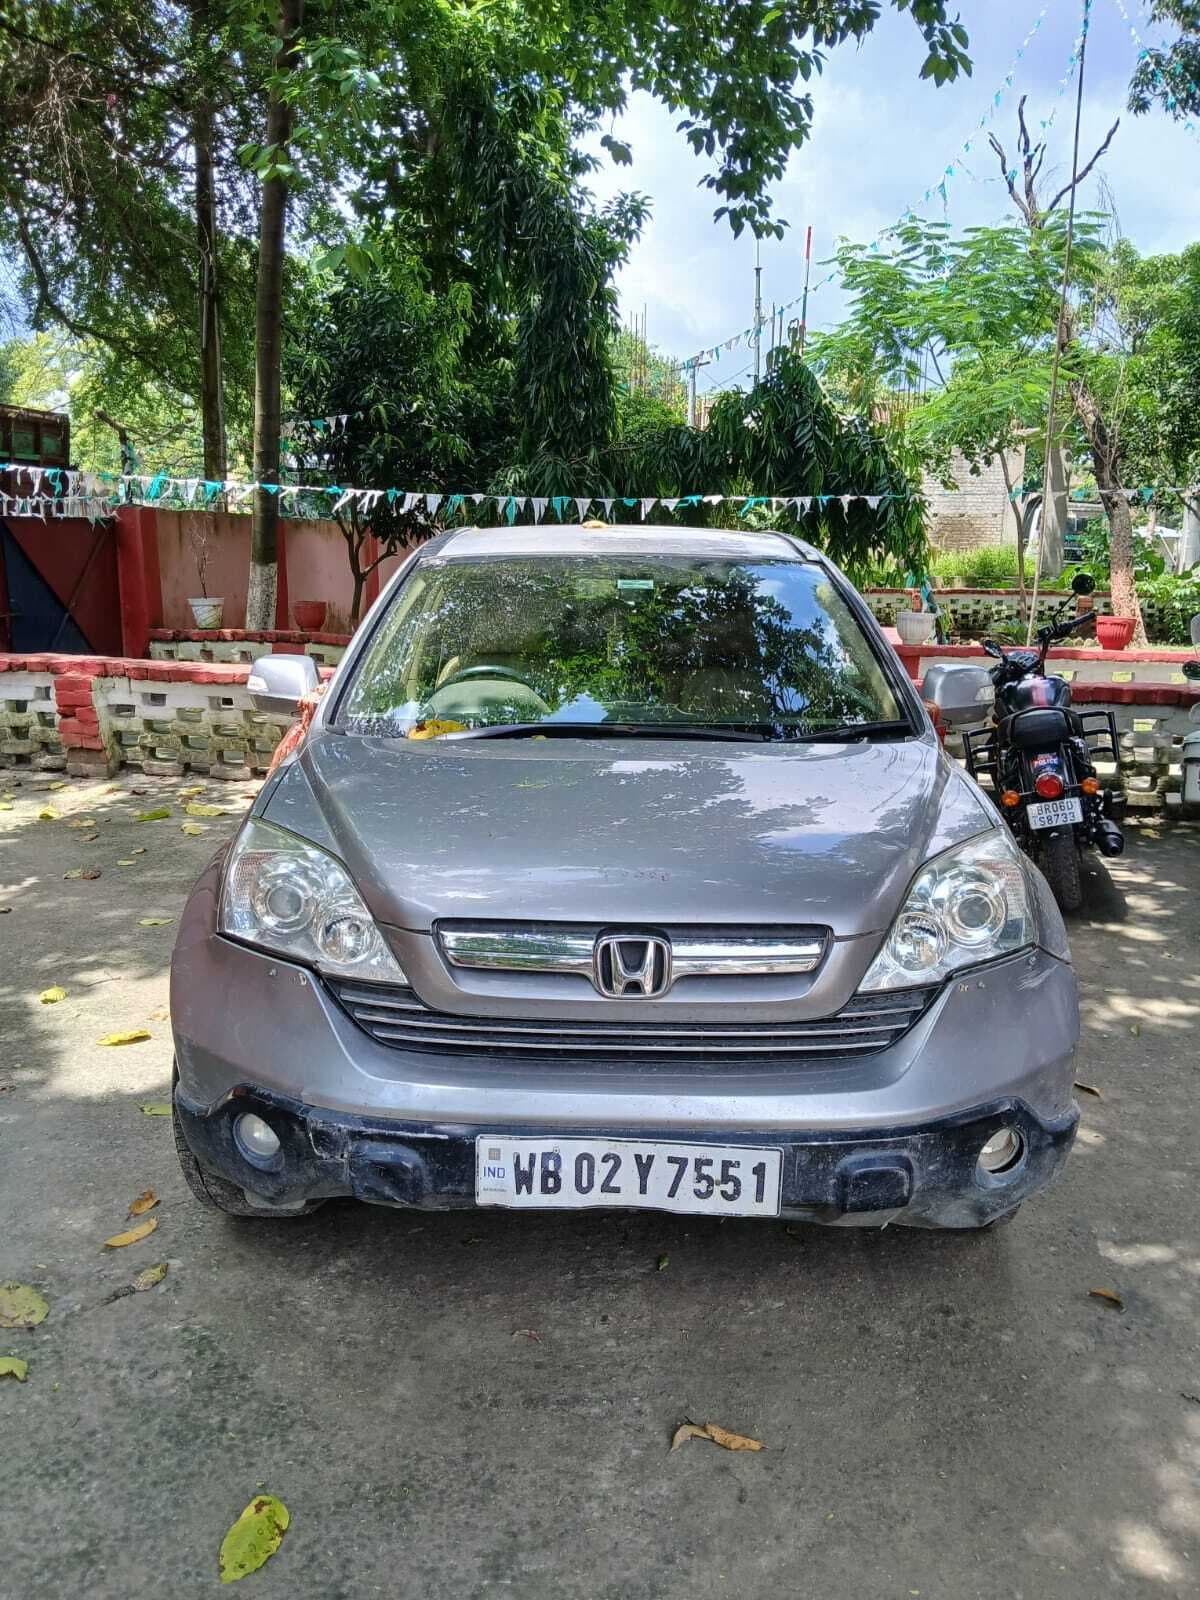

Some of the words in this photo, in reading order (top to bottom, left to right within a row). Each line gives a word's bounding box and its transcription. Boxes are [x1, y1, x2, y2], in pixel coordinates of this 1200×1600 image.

[1037, 800, 1074, 815] BR06D
[1038, 812, 1076, 826] S8733
[483, 1166, 506, 1179] IND
[513, 1151, 562, 1195] WB
[574, 1152, 622, 1195] 02
[633, 1153, 656, 1195] Y
[666, 1155, 767, 1204] 7551
